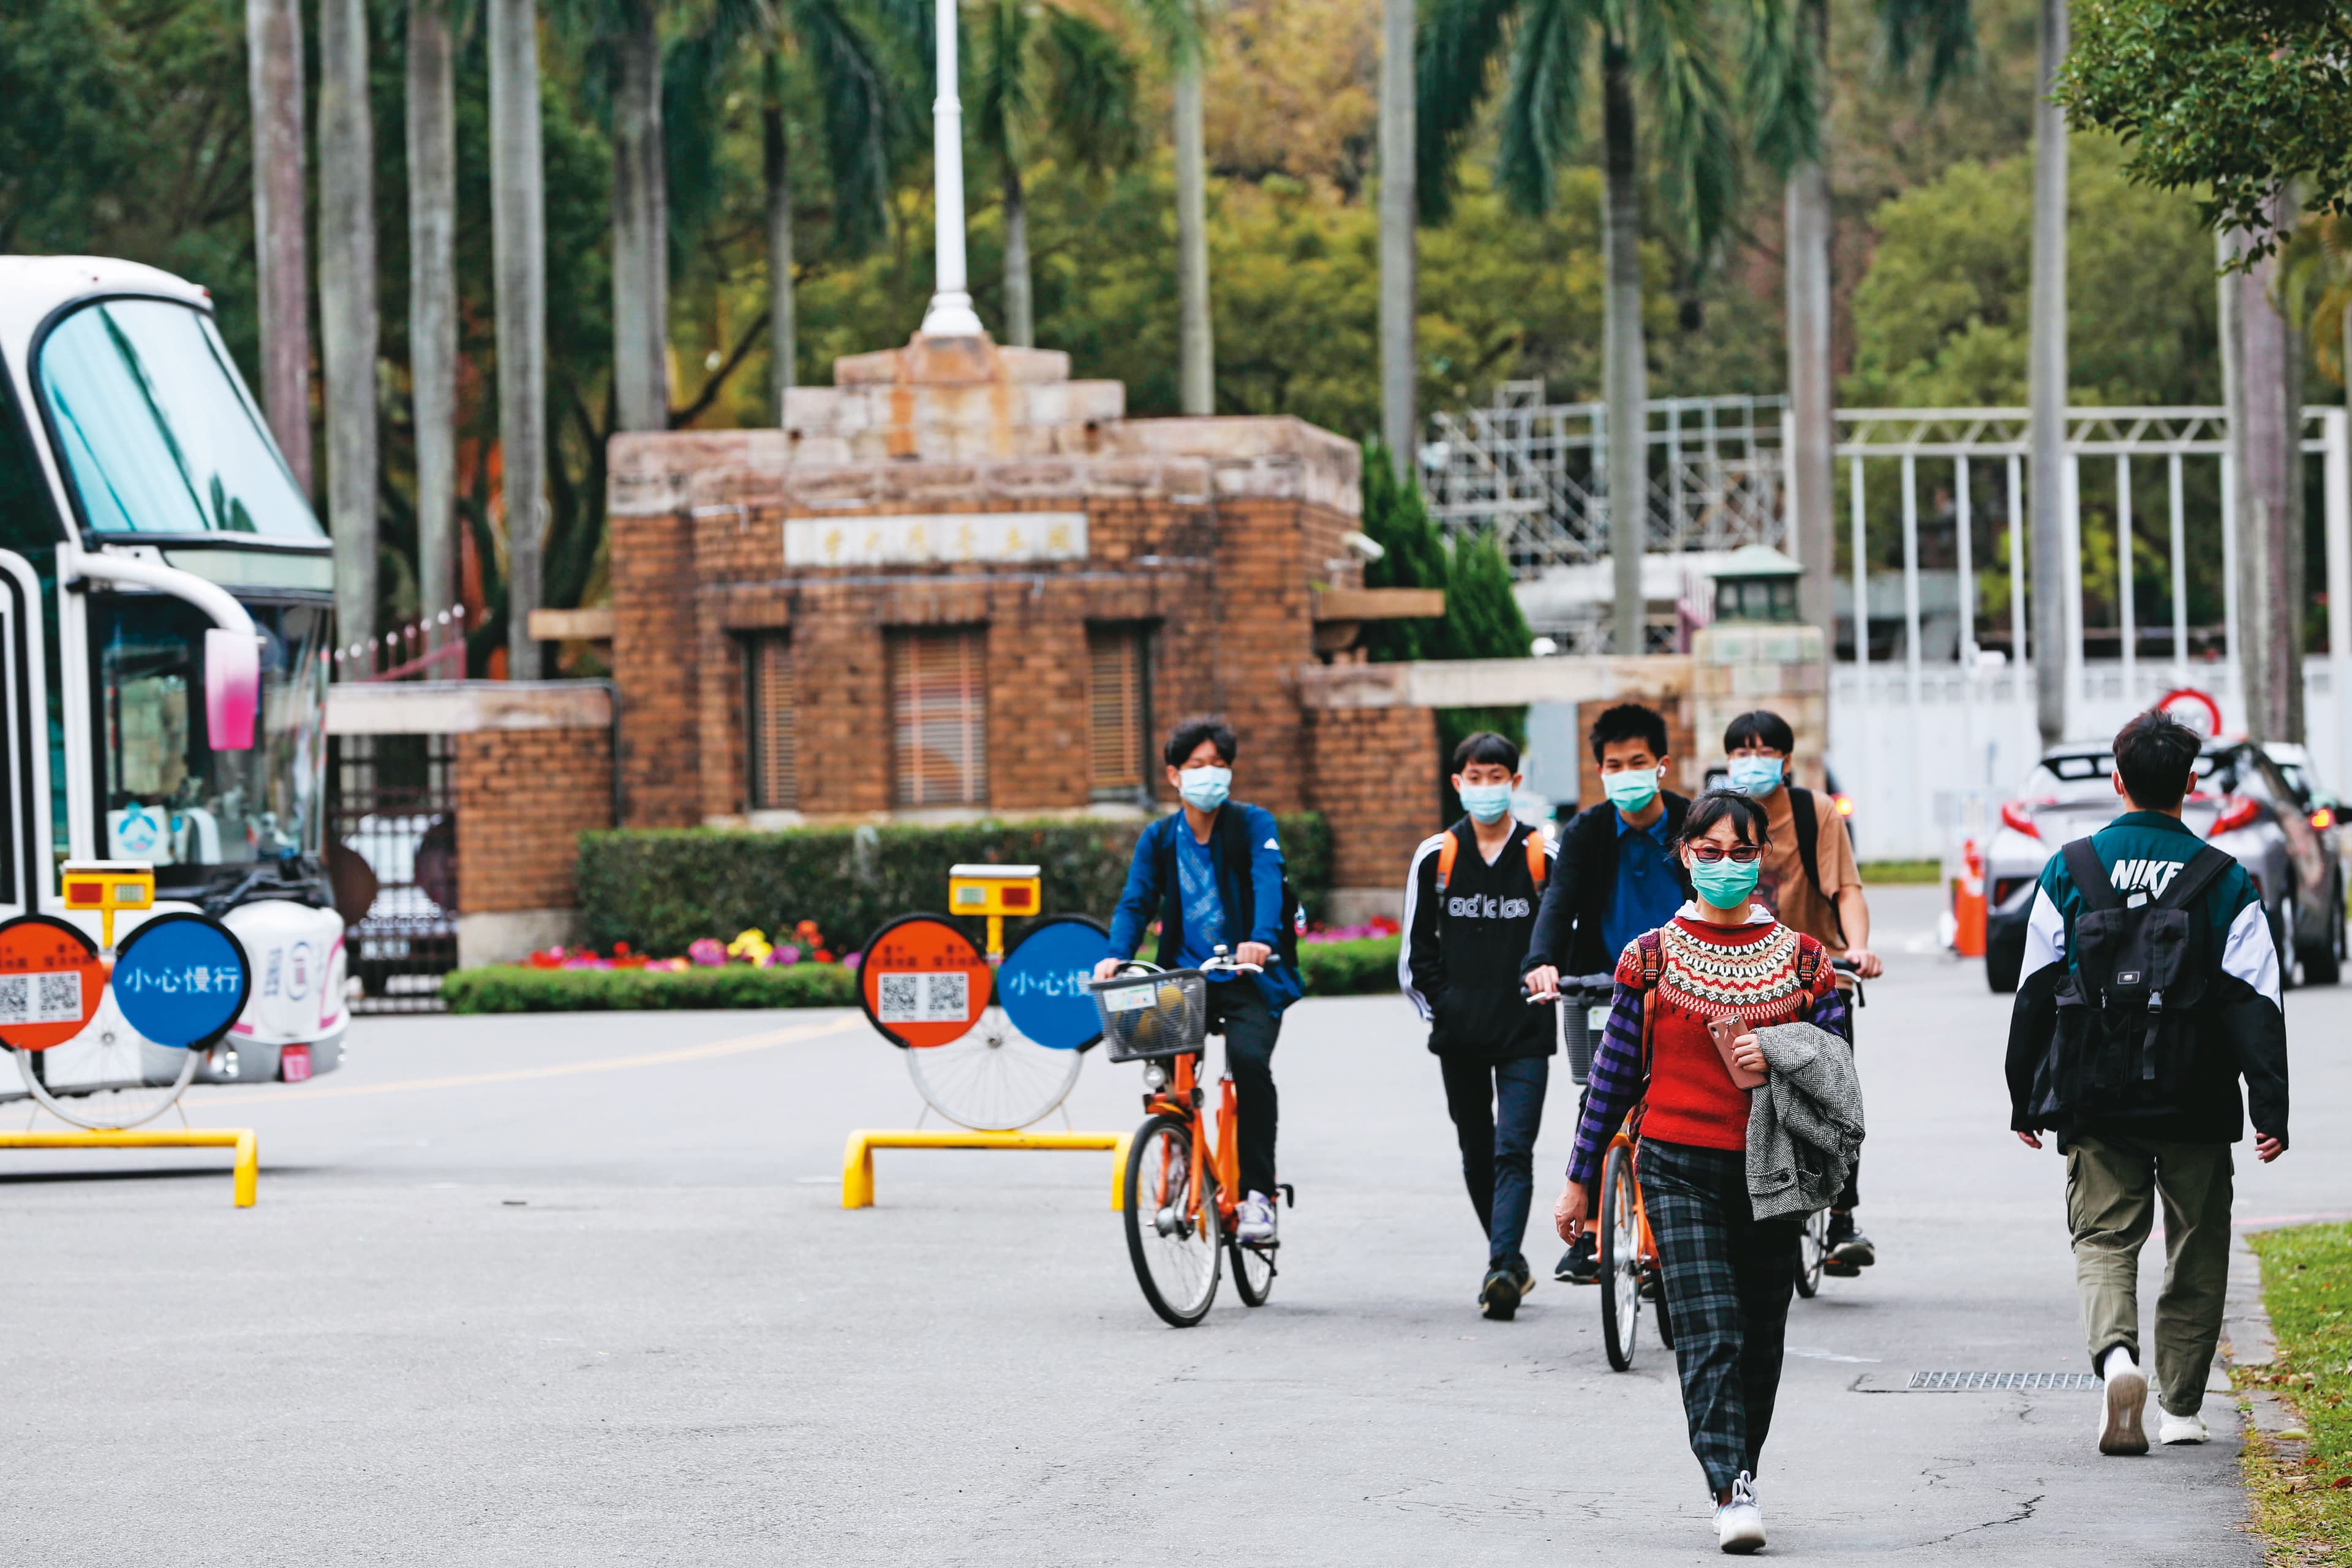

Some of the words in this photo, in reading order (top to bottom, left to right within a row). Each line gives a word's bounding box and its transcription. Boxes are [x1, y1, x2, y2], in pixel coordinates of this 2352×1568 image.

[1447, 892, 1530, 919] adidas
[124, 966, 240, 993] 小心慢行
[1009, 969, 1094, 997] 小心慢
